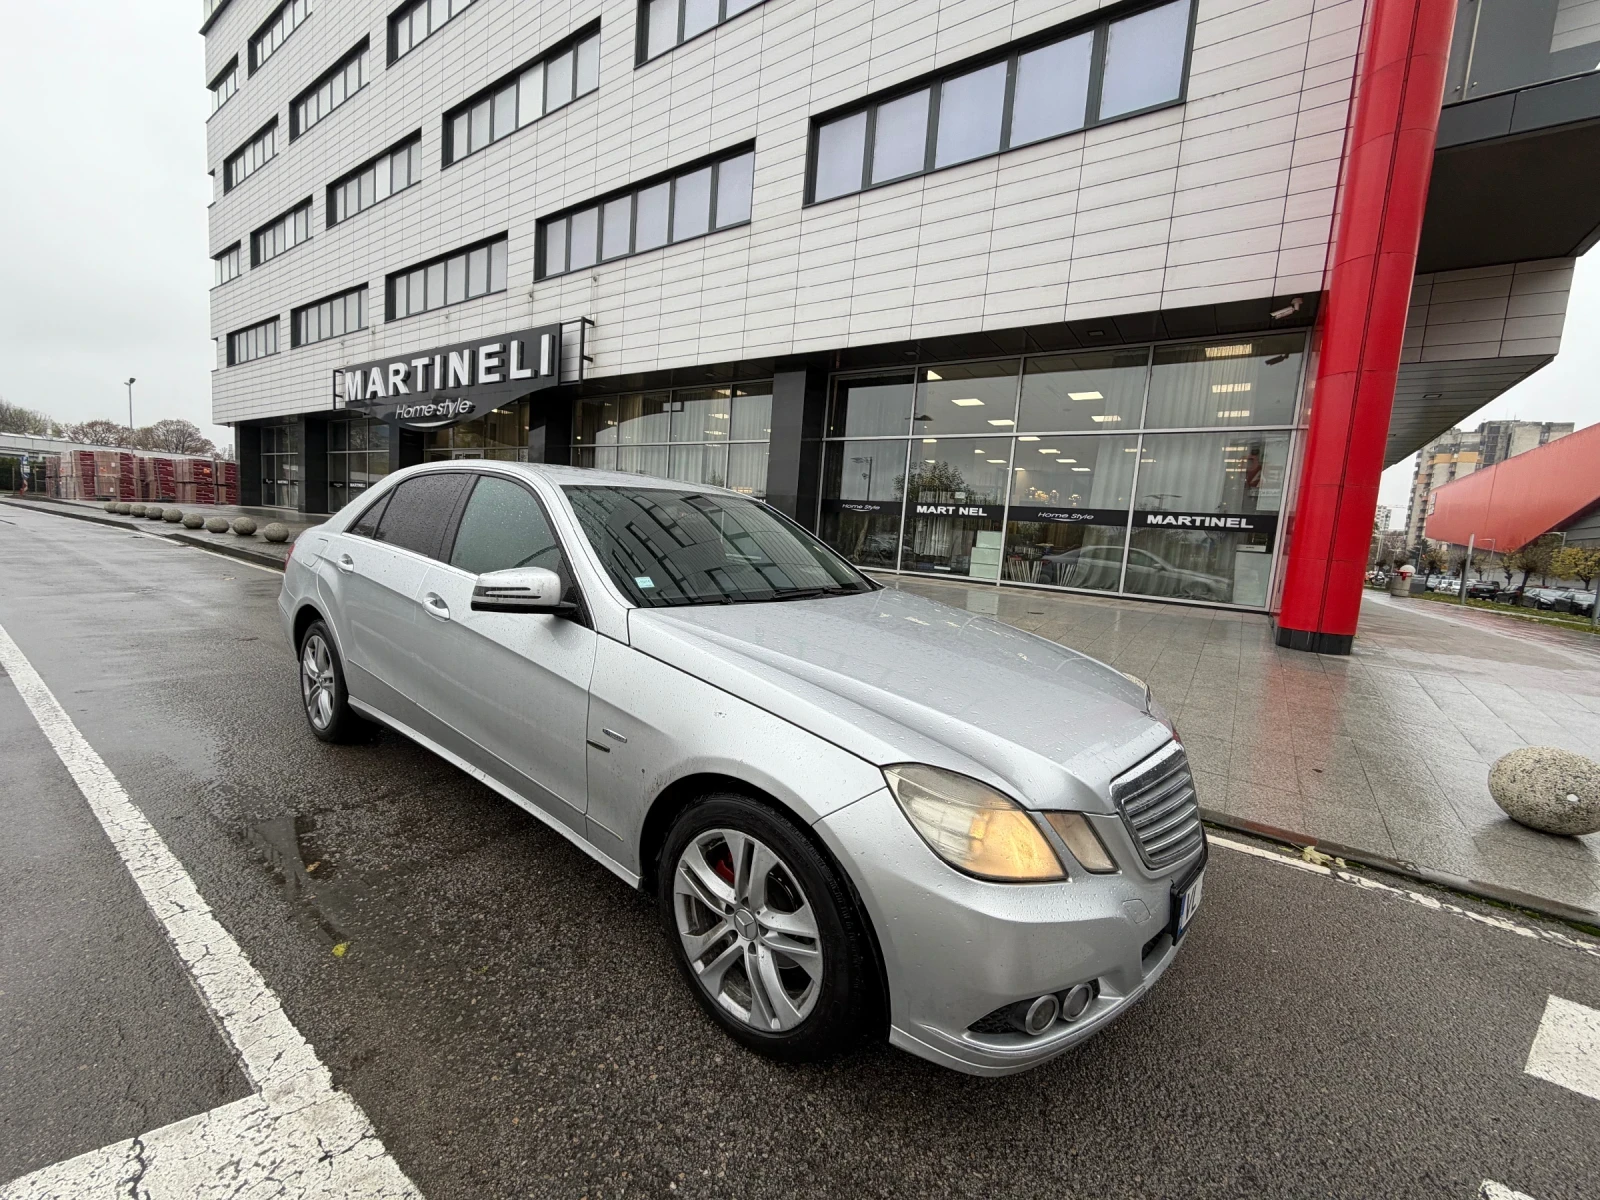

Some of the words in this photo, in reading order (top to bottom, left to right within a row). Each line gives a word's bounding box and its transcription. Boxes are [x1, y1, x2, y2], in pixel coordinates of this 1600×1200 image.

[344, 333, 553, 402] MARTINELI
[395, 404, 435, 419] Home
[436, 398, 472, 418] style
[916, 505, 956, 515] MART
[958, 506, 988, 516] NEL
[1037, 511, 1069, 519] Home
[1146, 514, 1254, 529] MARTINEL
